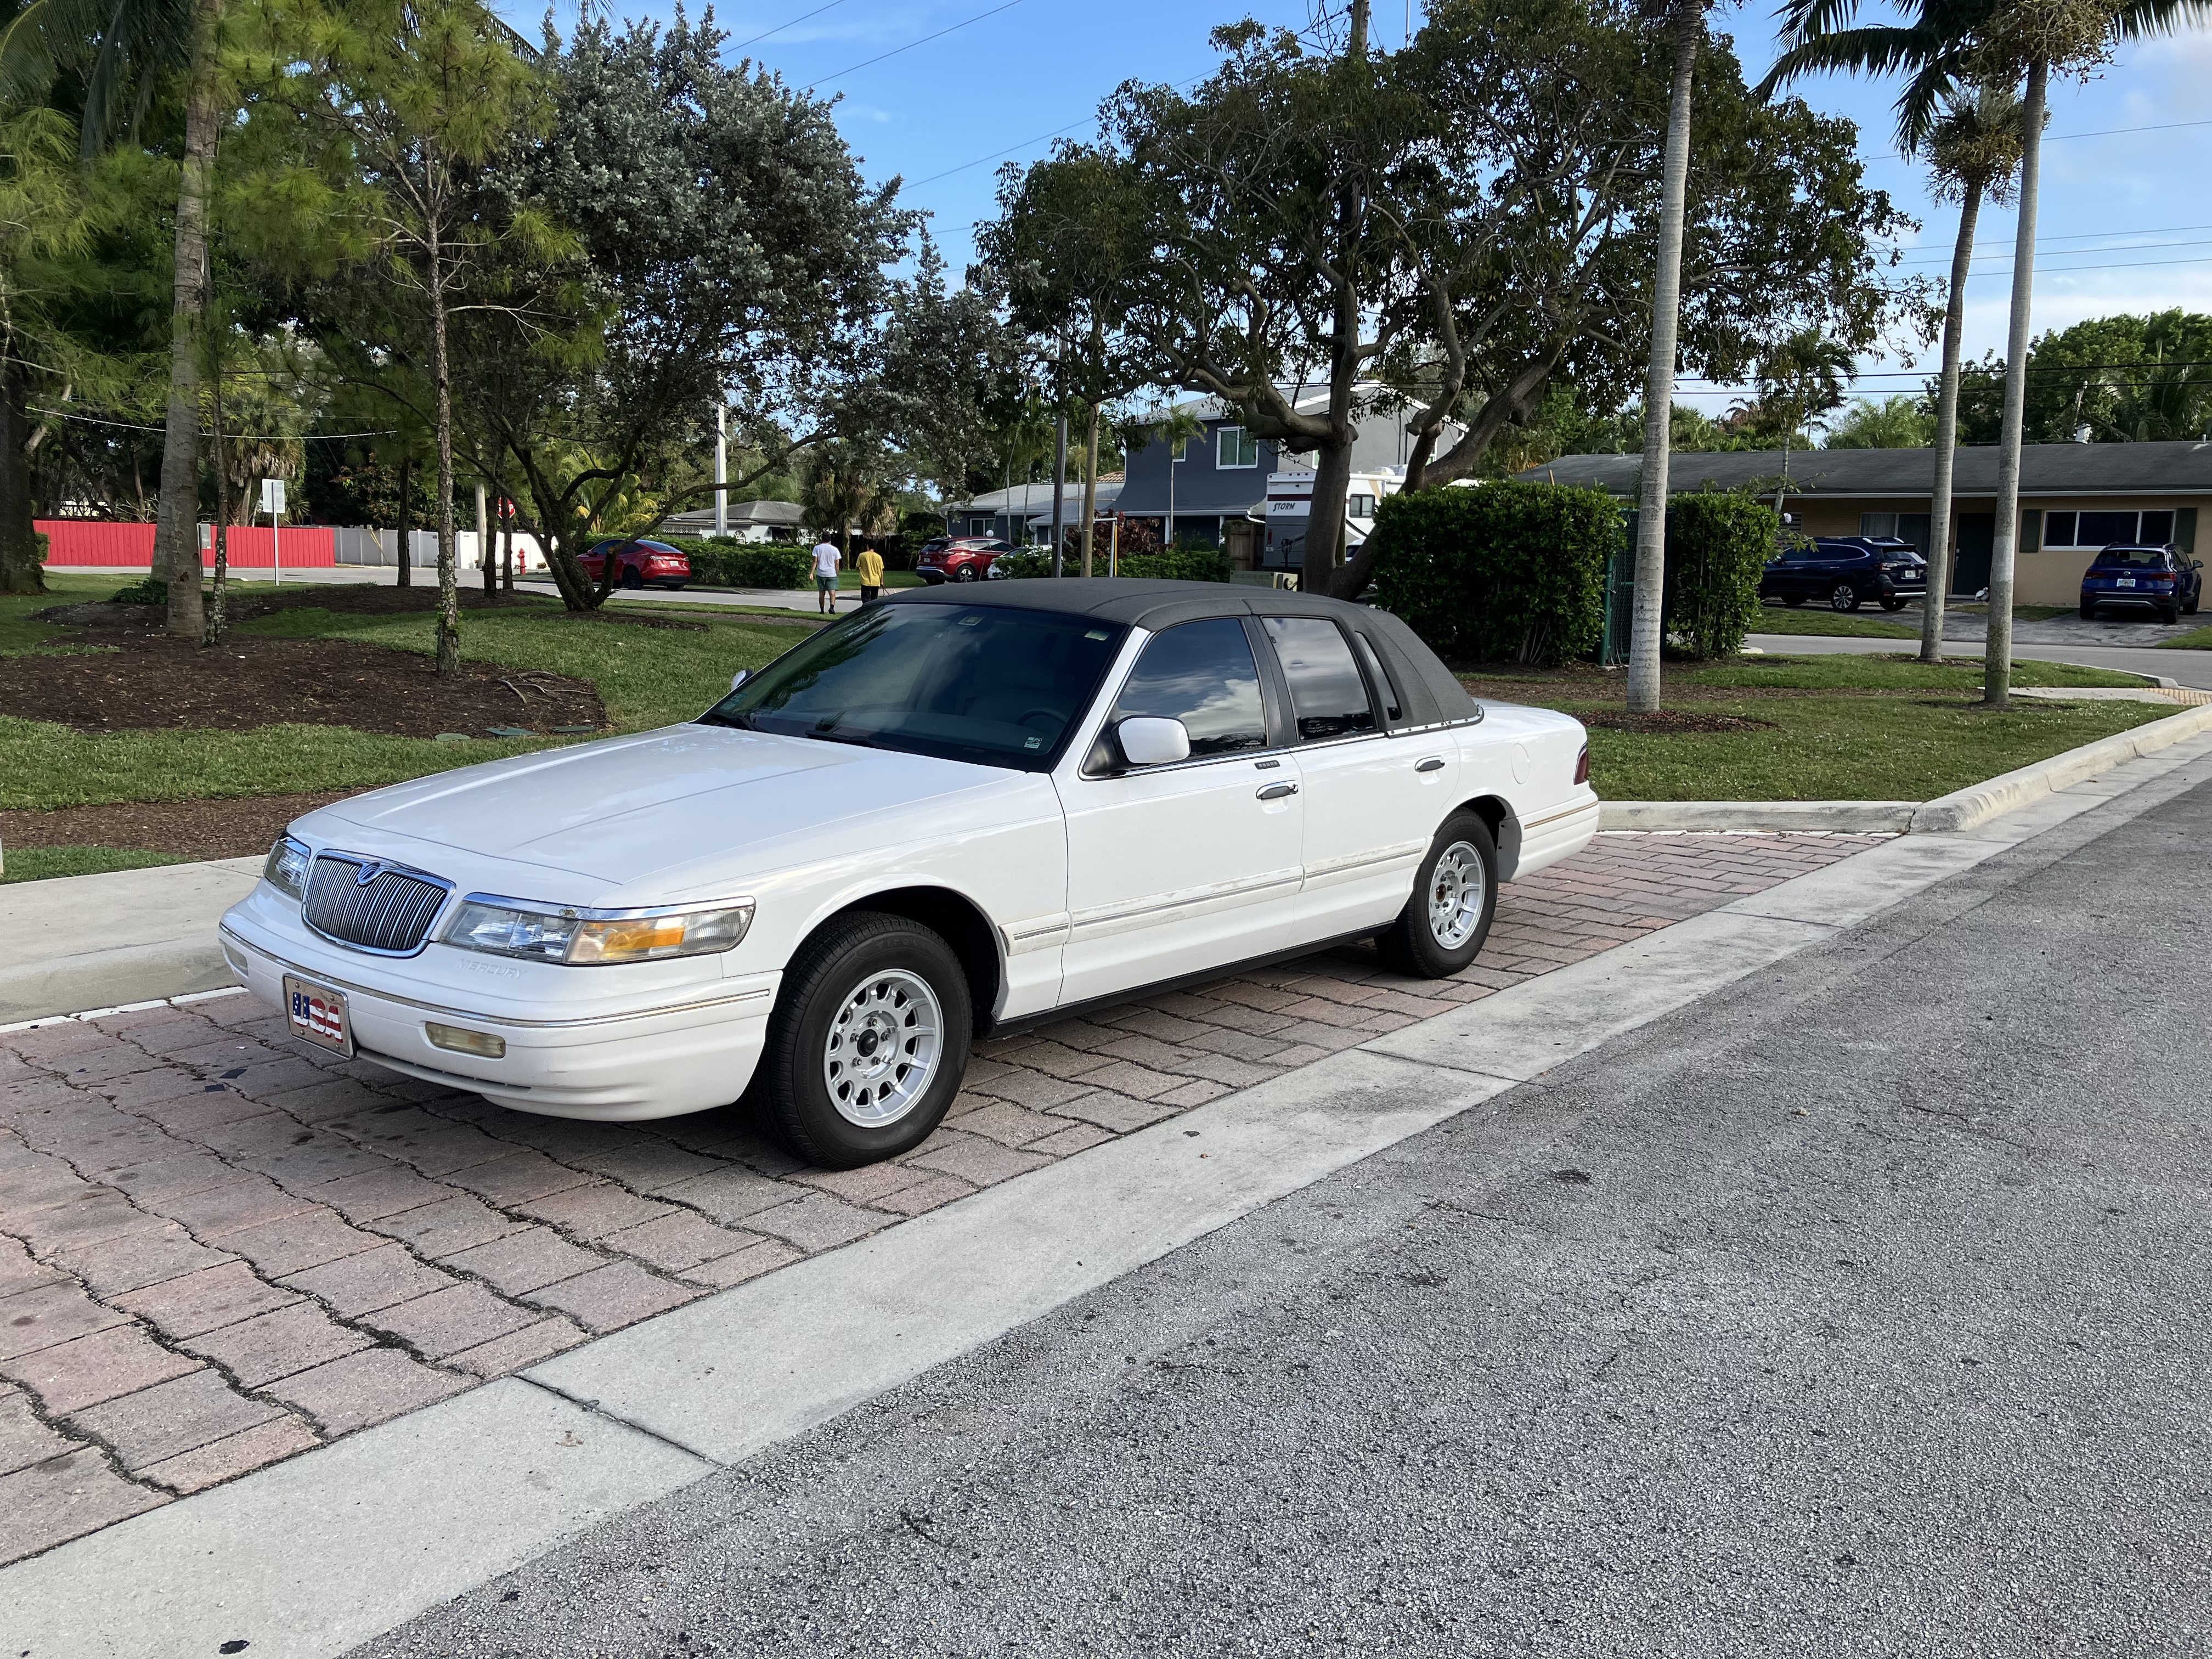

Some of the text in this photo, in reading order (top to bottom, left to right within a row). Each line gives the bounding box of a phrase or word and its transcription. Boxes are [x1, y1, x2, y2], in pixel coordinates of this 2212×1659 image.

[498, 504, 514, 512] SP
[1272, 502, 1296, 512] STORM
[455, 958, 528, 979] MERCURY
[292, 991, 343, 1043] USA
